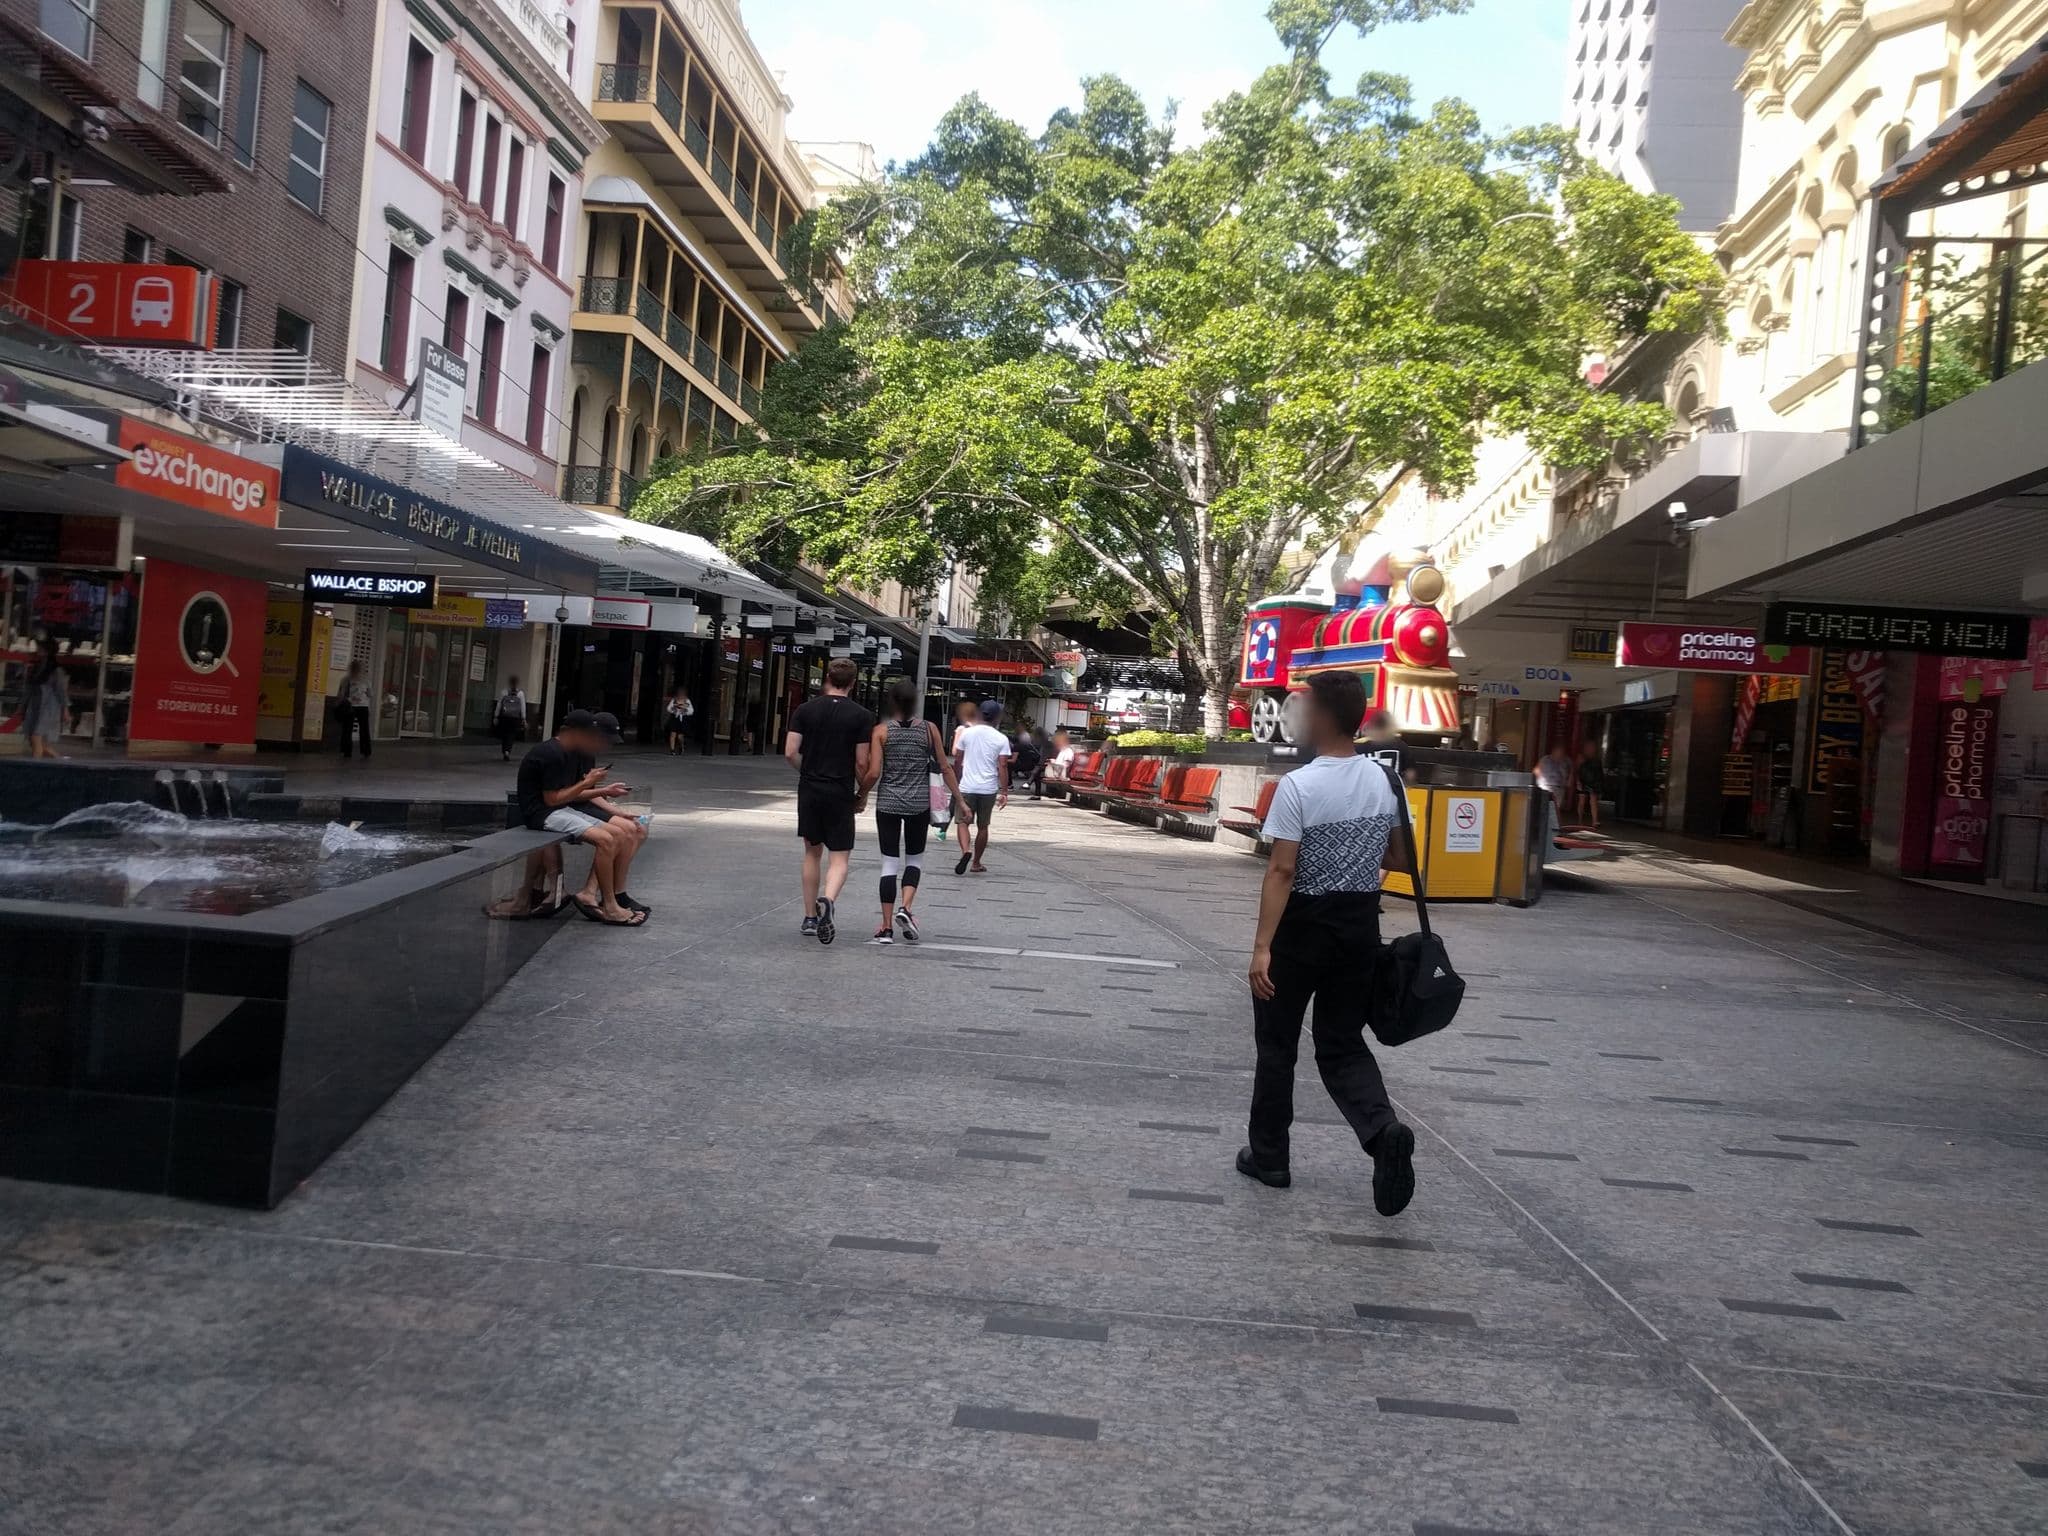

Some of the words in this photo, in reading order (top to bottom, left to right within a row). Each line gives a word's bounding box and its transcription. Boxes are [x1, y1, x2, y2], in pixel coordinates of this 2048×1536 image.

[727, 50, 770, 136] CARLTON
[67, 282, 96, 324] 2
[426, 344, 443, 368] For
[443, 353, 466, 382] lease
[134, 447, 264, 511] exchange
[321, 470, 397, 521] WALLACE
[463, 524, 521, 563] JEWELLER
[311, 574, 373, 591] WALLACE
[592, 609, 628, 621] estpac
[1680, 632, 1756, 648] priceline
[1784, 611, 1932, 646] FOREVER
[1943, 621, 2008, 650] NEW
[1020, 666, 1028, 674] 2
[1679, 647, 1755, 665] pharmacy
[1525, 667, 1560, 681] BOQ
[1482, 682, 1510, 695] ATM
[157, 699, 213, 714] STOREWIDE
[214, 703, 238, 716] SALE
[1944, 707, 1968, 798] priceline
[1964, 708, 1993, 800] pharmacy
